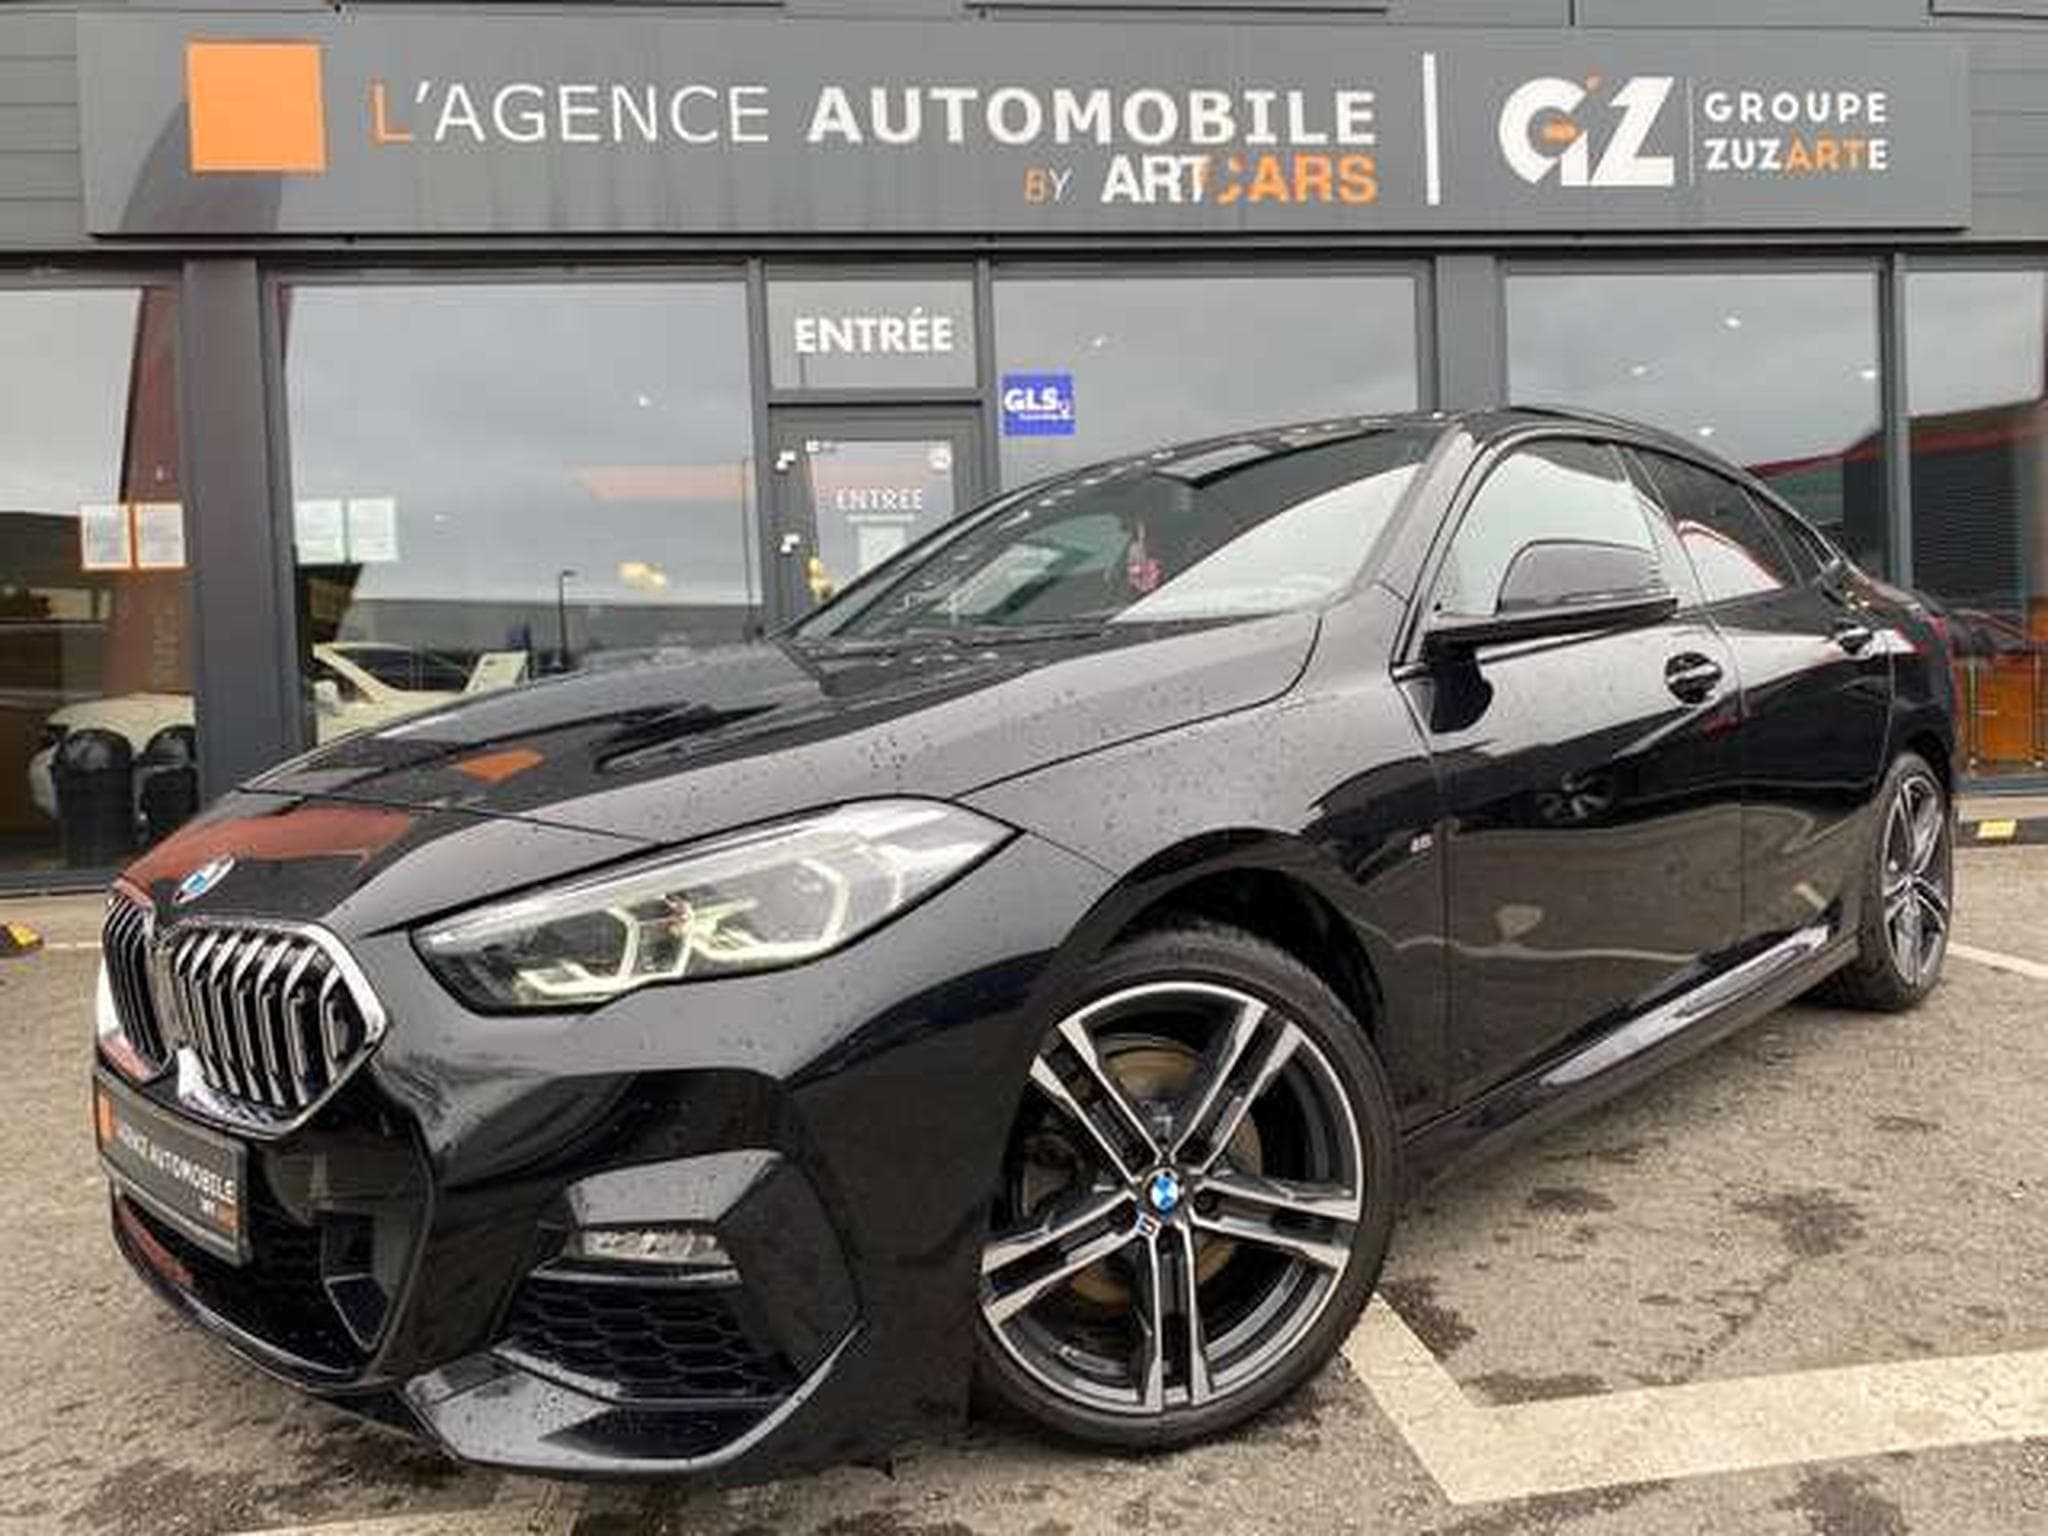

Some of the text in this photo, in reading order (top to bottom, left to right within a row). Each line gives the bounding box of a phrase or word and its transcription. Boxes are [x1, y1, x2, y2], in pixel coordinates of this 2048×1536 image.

[372, 80, 1379, 146] L'AGENCE AUTOMOBILE
[1703, 91, 1888, 123] GROUPE
[1703, 137, 1888, 171] ZUZARTE
[1025, 167, 1073, 202] BY
[794, 305, 954, 353] ENTRÉE
